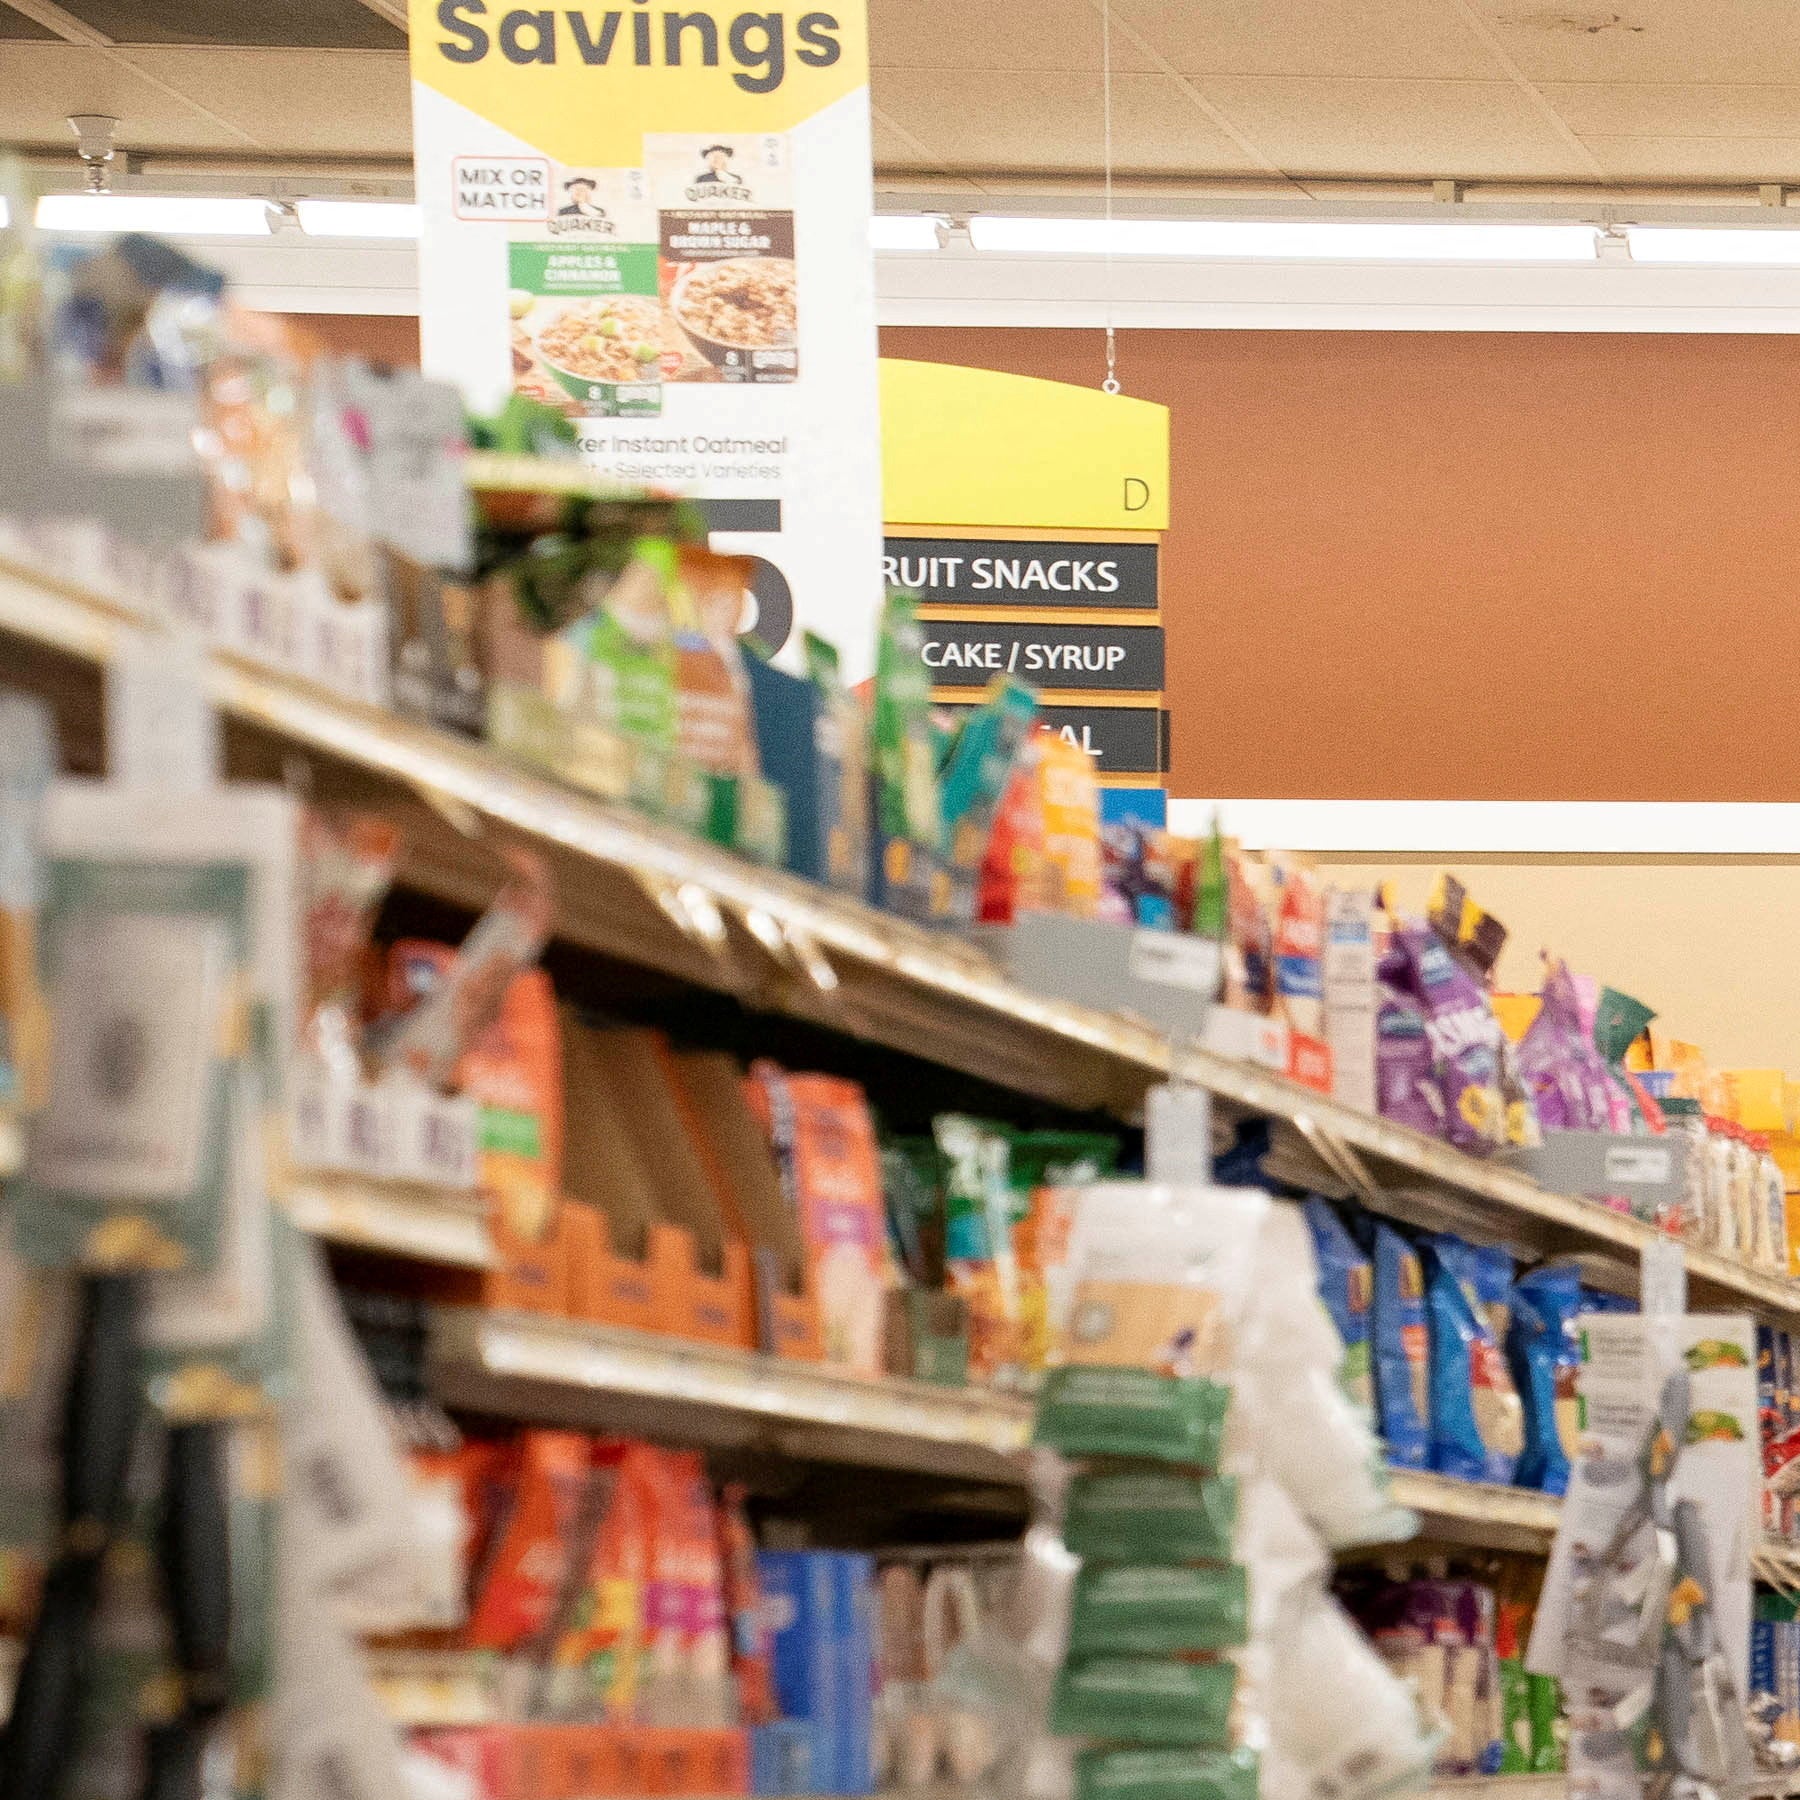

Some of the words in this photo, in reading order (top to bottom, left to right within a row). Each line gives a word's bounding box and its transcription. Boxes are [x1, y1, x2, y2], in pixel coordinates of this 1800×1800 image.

[437, 0, 842, 94] Savings
[460, 169, 503, 185] MIX
[511, 169, 543, 185] OR
[460, 192, 546, 208] MATCH
[685, 186, 752, 202] QUAKER
[546, 217, 617, 235] QUAKER
[575, 437, 606, 454] ker
[612, 436, 688, 454] Instant
[693, 436, 788, 454] Oatmeal
[616, 462, 696, 480] Selected
[702, 462, 781, 480] Varieties
[1124, 478, 1149, 511] D
[880, 556, 963, 589] RUIT
[971, 559, 1120, 593] SNACKS
[921, 642, 1002, 668] CAKE
[1024, 644, 1126, 672] SYRUP
